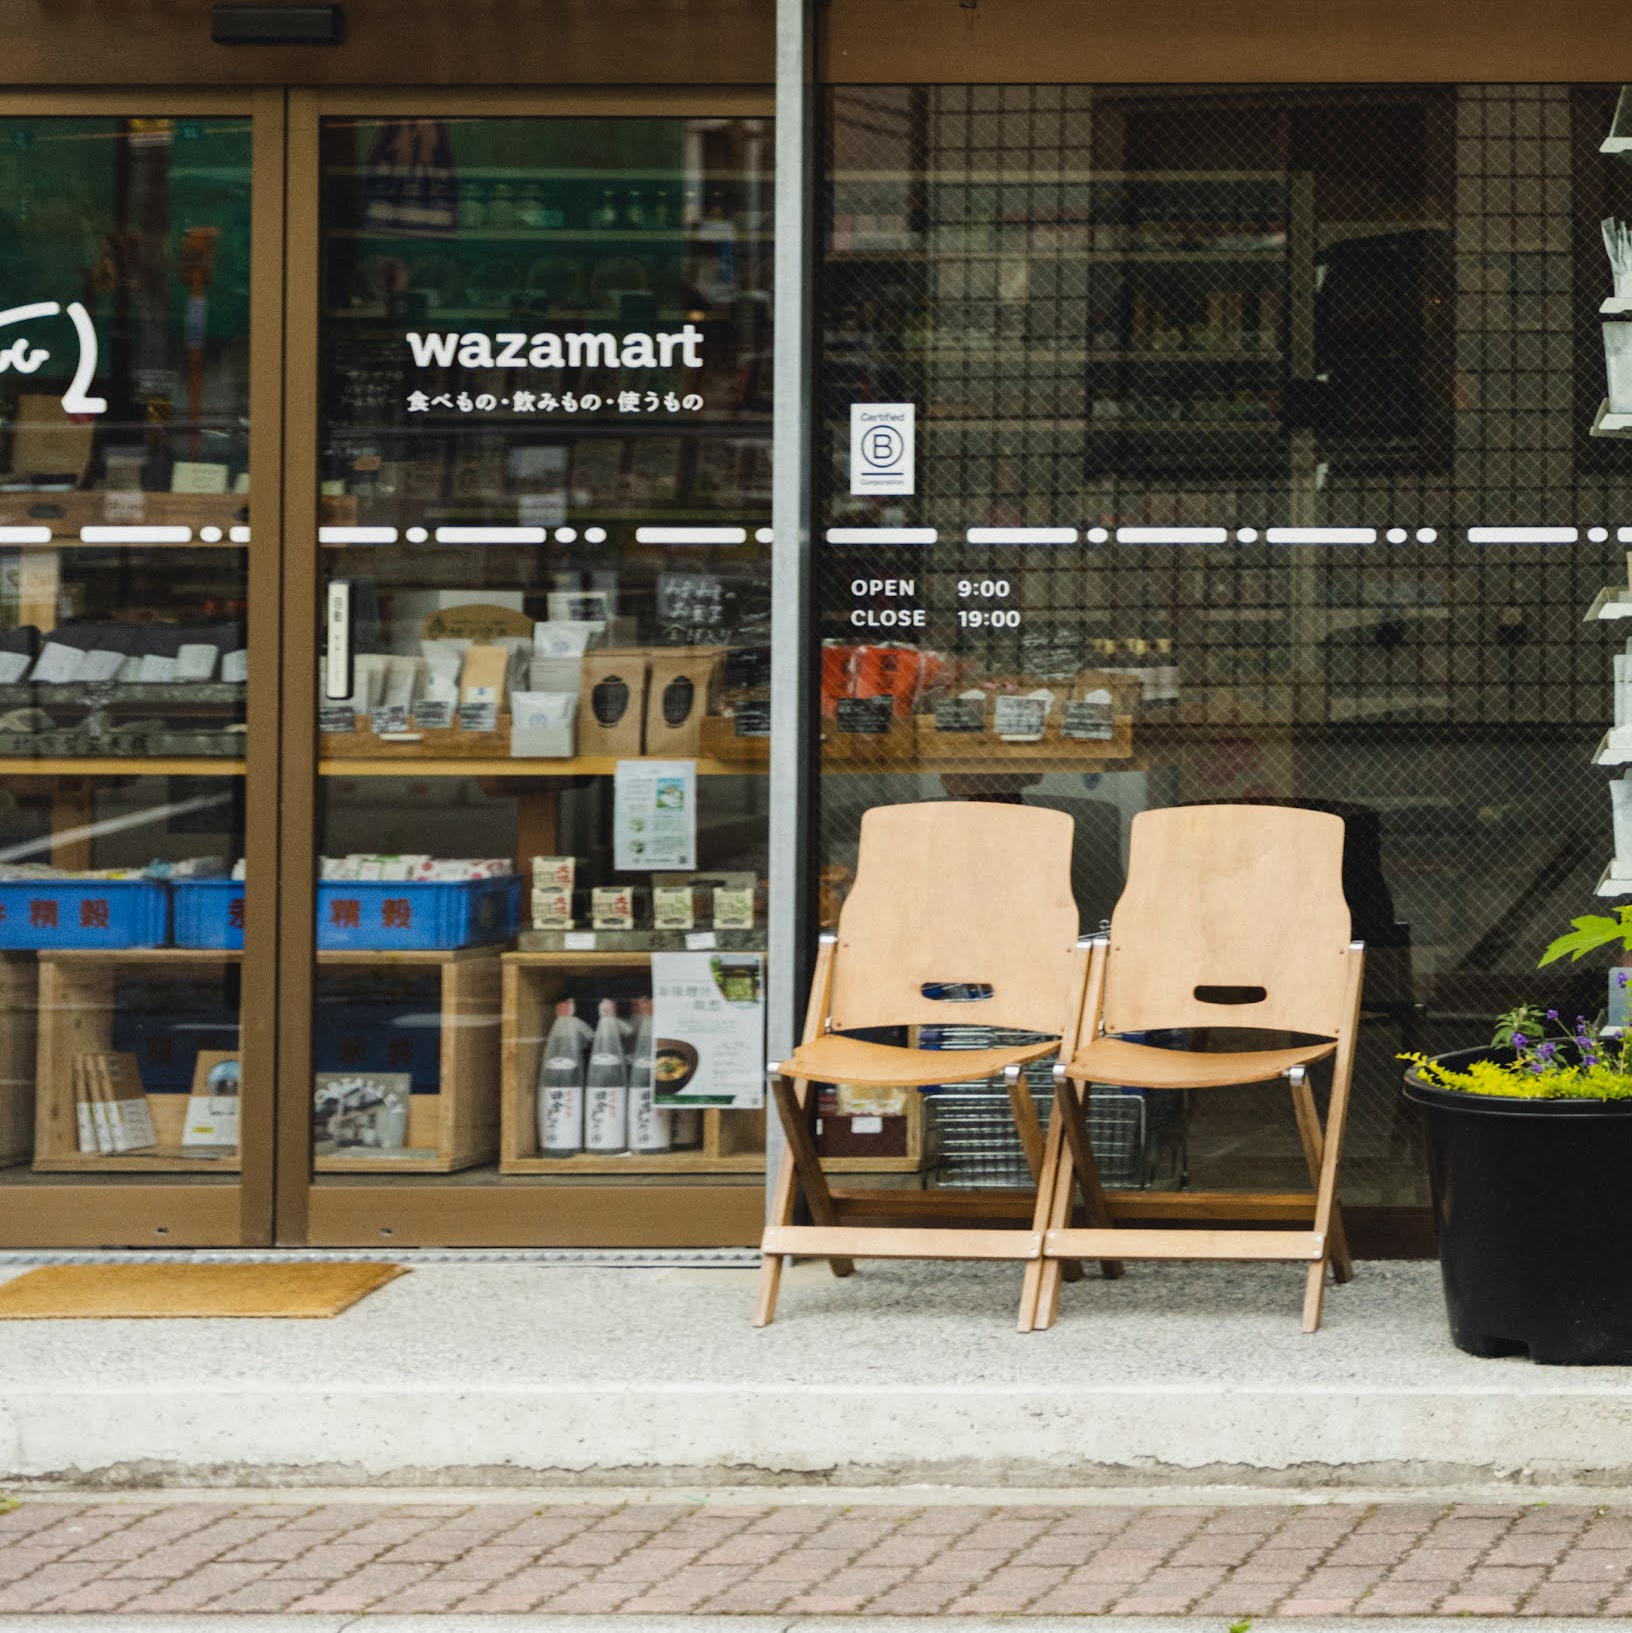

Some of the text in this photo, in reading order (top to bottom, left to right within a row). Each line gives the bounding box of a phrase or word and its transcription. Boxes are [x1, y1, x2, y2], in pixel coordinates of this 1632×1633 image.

[405, 324, 704, 368] wazamart
[860, 412, 905, 422] Certified
[873, 433, 893, 459] B
[850, 579, 1011, 598] OPEN 9:00
[850, 609, 1022, 628] CLOSE 19:00
